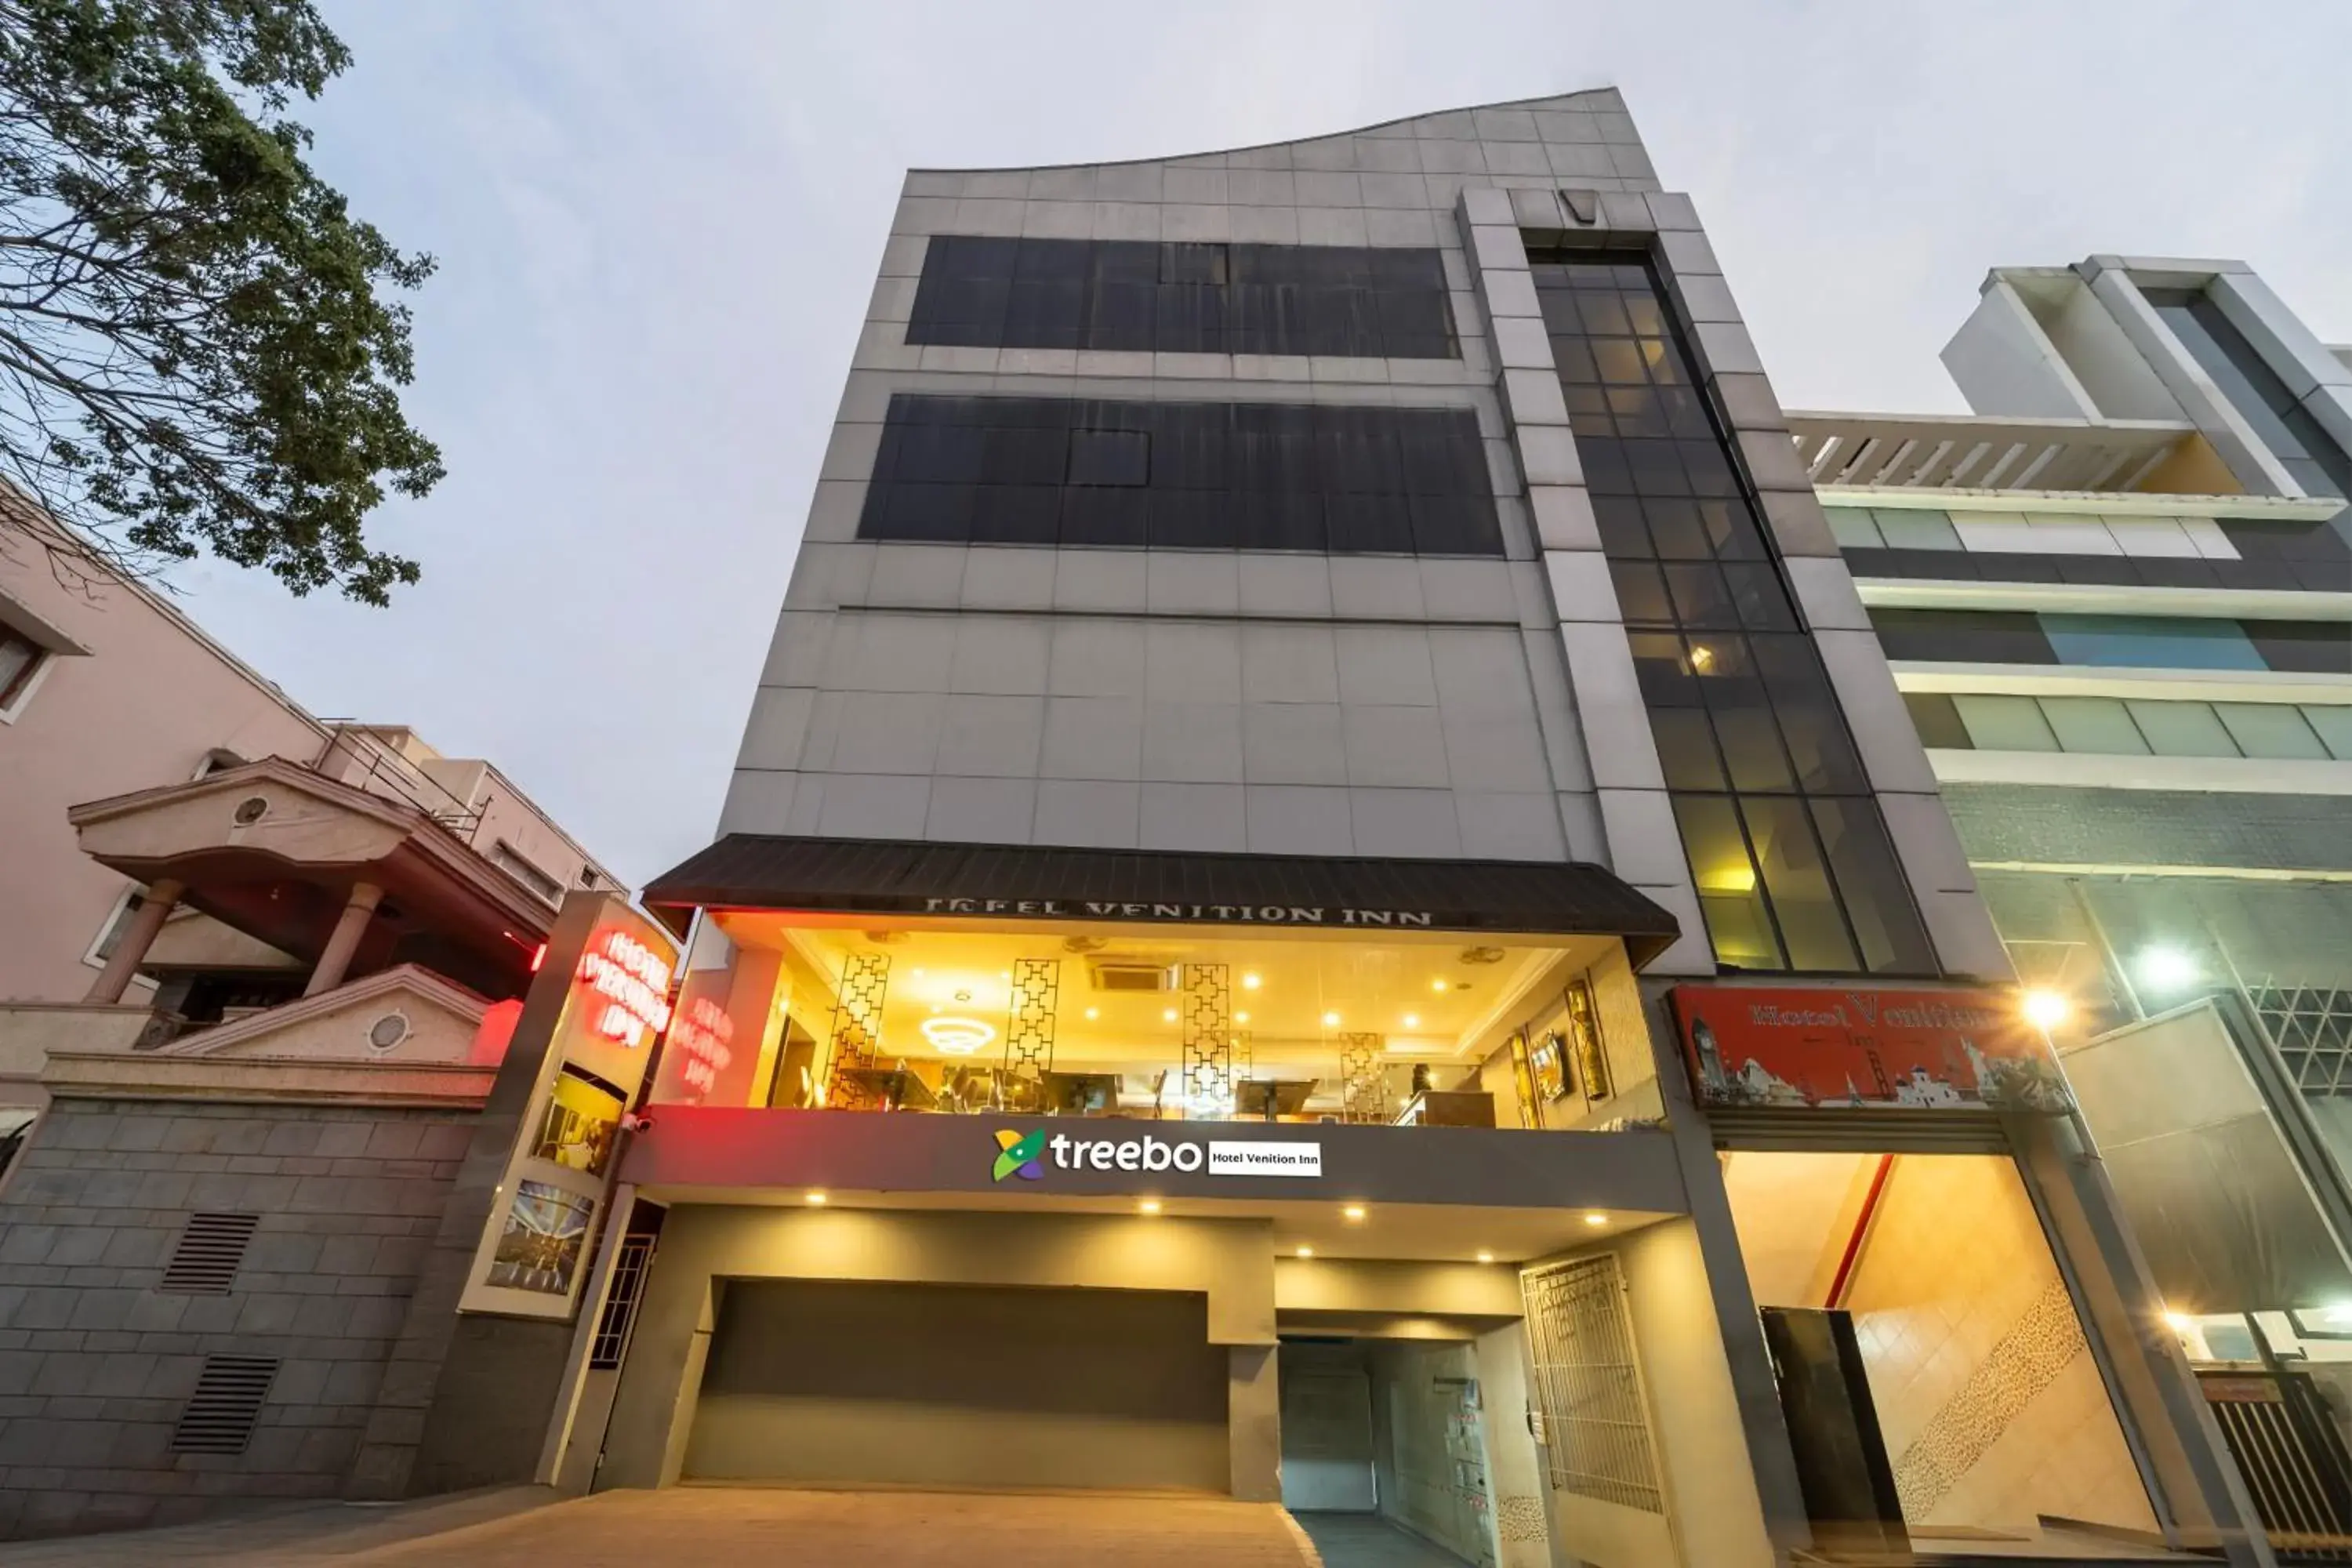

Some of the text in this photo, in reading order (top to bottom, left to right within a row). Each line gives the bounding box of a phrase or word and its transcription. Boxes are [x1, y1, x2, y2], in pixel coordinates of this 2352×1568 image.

[1341, 909, 1432, 926] INN
[1049, 1132, 1203, 1172] treebo
[1213, 1153, 1319, 1164] Hotel Venition Inn
